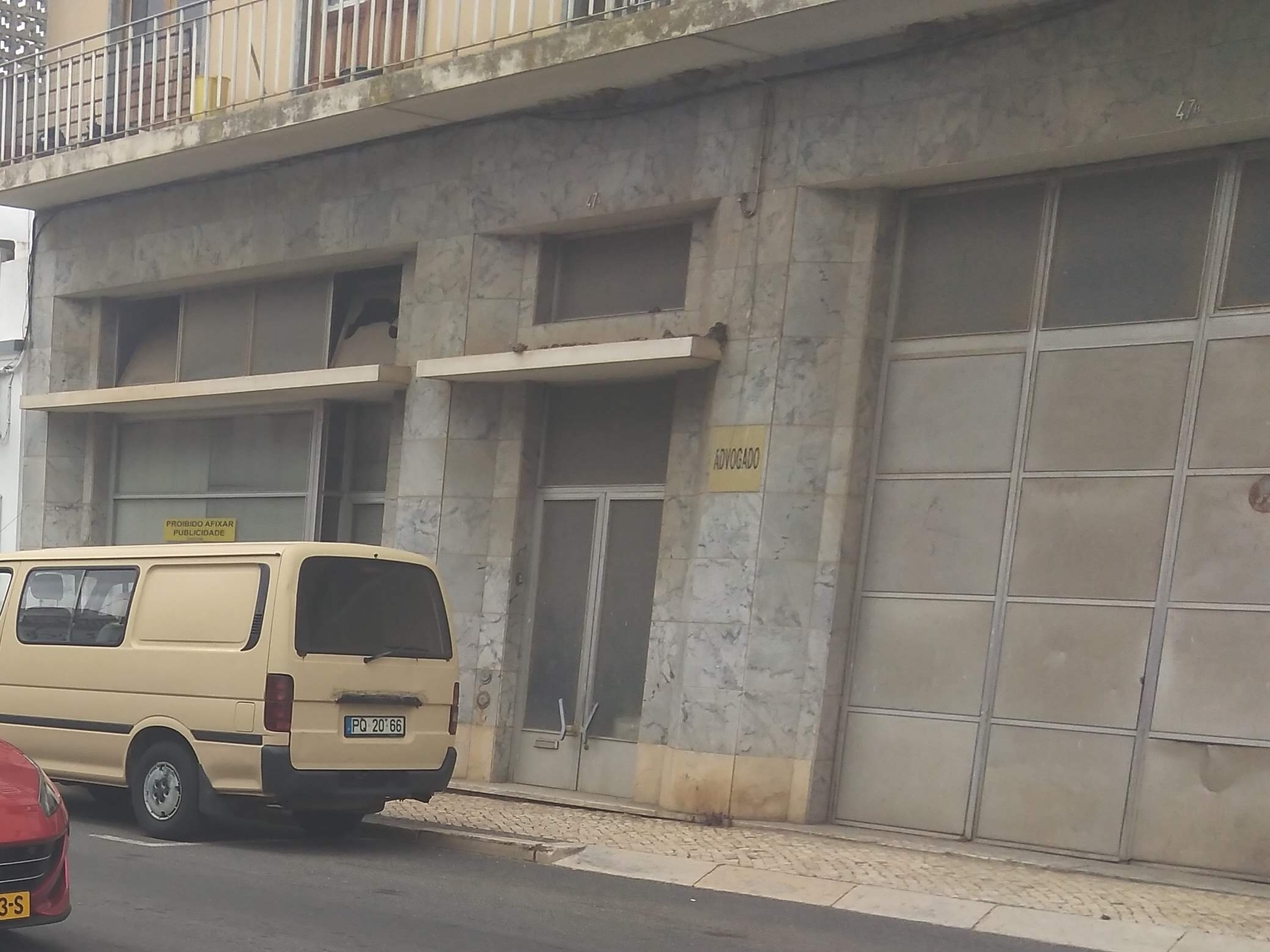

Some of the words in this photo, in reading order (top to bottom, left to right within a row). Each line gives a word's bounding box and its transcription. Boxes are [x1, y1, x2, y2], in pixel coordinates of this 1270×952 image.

[713, 447, 760, 470] ADVOGADO
[173, 529, 225, 537] PUBLICIDADE
[352, 718, 367, 732] PQ
[389, 718, 402, 732] 66
